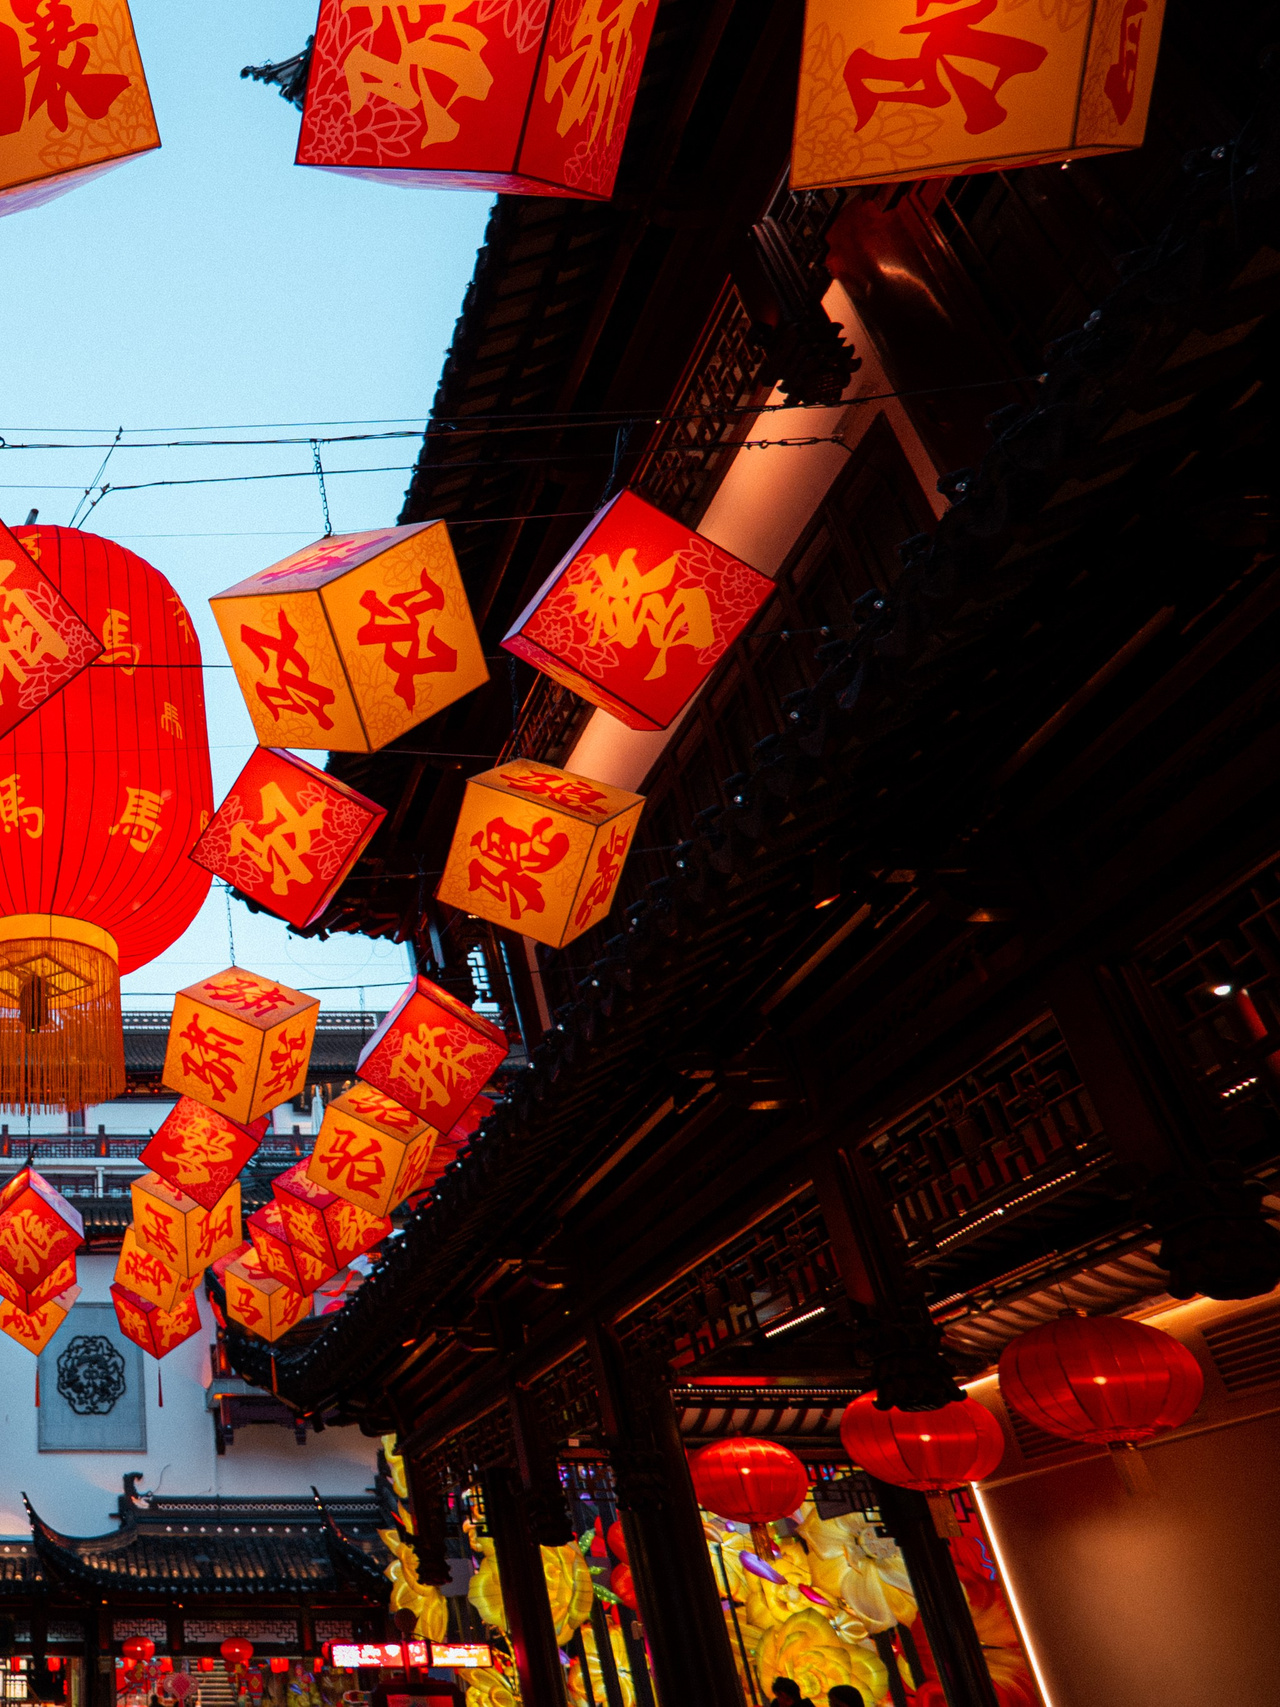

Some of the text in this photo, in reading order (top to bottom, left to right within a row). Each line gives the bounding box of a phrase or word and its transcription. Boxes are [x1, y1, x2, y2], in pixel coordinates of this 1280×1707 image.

[241, 605, 336, 732] 驭
[357, 567, 458, 714] 驭
[109, 786, 165, 853] 馬
[228, 781, 327, 896] 驭
[390, 1022, 487, 1110] 骤
[231, 1287, 264, 1328] 马
